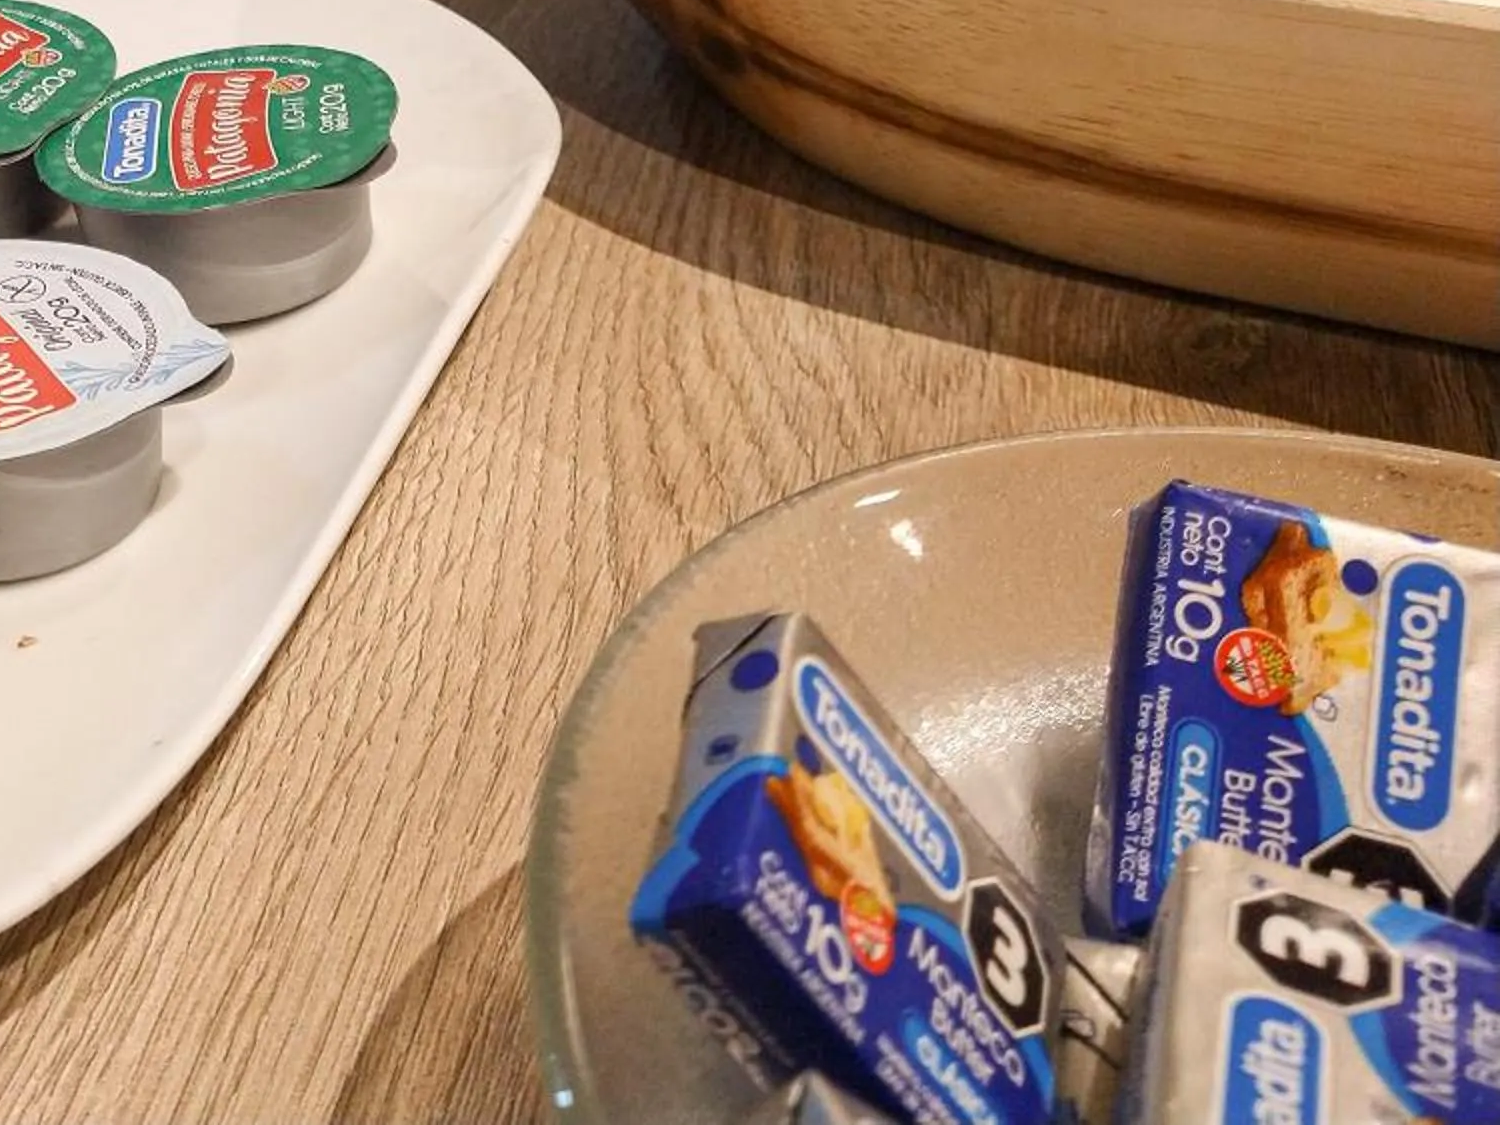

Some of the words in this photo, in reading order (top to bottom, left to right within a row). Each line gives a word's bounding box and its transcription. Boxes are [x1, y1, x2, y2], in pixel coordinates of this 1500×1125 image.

[115, 106, 149, 179] Tonadita
[205, 74, 256, 181] Patagonia
[282, 97, 306, 131] LIGHT
[48, 297, 92, 327] 20g
[1154, 506, 1176, 580] INDUSTRIA
[1180, 512, 1205, 566] neto
[1144, 582, 1167, 667] ARGENTINA
[1165, 578, 1226, 664] 10g
[1386, 585, 1452, 802] Tonadita
[813, 676, 947, 873] Tonadita
[1171, 744, 1210, 857] CLÁSIC
[1219, 768, 1258, 848] Butte
[1258, 734, 1306, 864] Mante
[805, 904, 869, 1014] 10g
[984, 906, 1027, 1007] 3
[1260, 913, 1371, 987] 3
[907, 927, 1025, 1087] Manteca
[1406, 952, 1457, 1108] Manteca
[1241, 1018, 1307, 1125] adita
